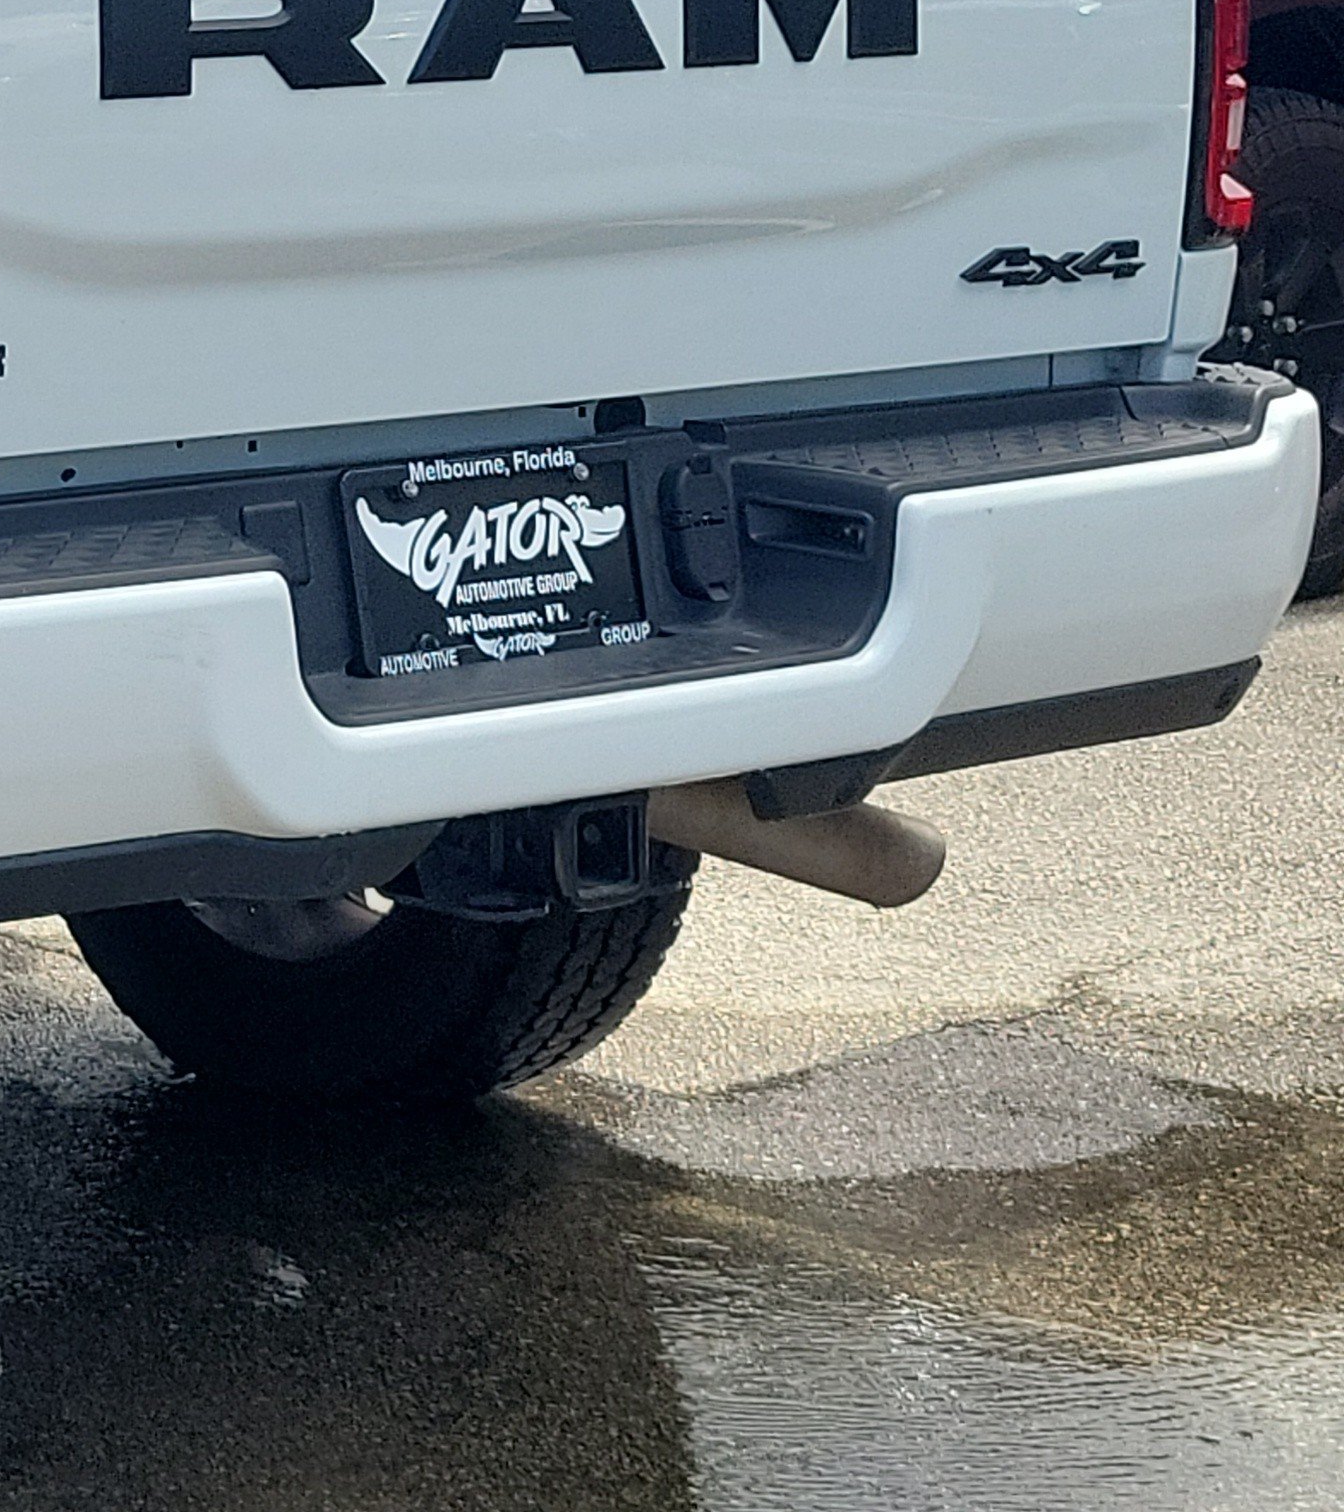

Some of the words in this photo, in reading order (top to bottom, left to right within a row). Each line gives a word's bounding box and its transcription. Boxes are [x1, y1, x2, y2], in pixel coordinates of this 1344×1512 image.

[408, 456, 510, 485] Melbourne,
[513, 446, 576, 473] Florida
[412, 496, 593, 609] GATOR
[455, 576, 536, 605] AUTOMOTIVE
[536, 571, 578, 594] GROUP
[380, 647, 459, 677] AUTOMOTIVE
[493, 632, 545, 661] GATOR
[600, 620, 652, 647] GROUP
